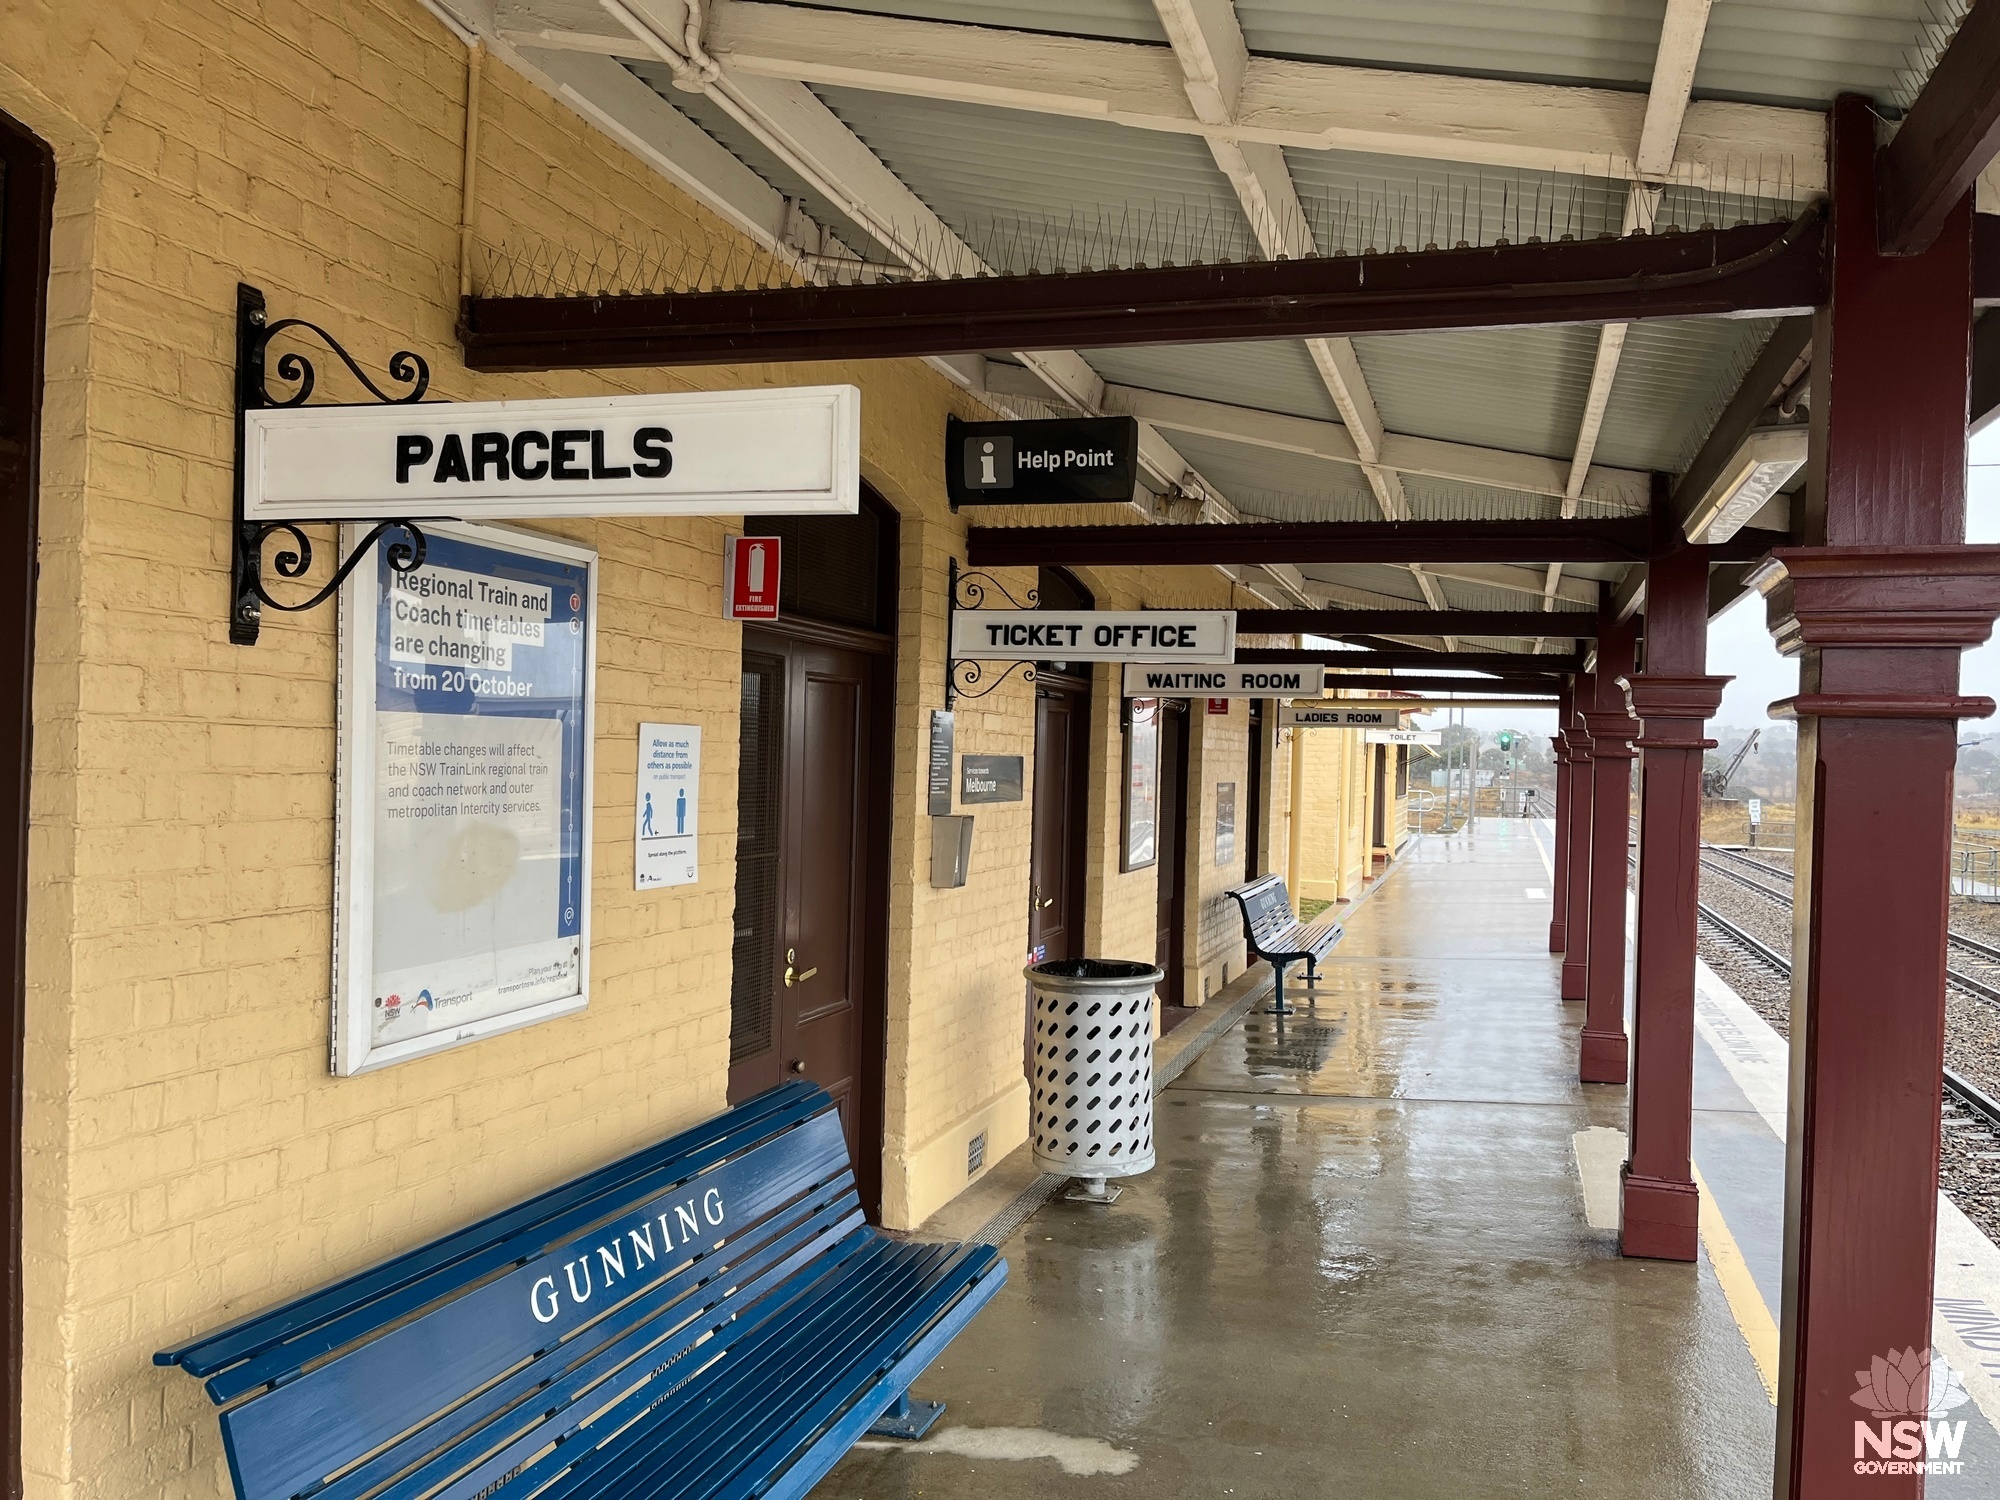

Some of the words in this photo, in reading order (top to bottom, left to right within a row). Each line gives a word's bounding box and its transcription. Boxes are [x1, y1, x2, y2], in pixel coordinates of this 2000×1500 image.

[395, 427, 673, 484] PARCELS
[1018, 450, 1061, 473] Help
[1064, 448, 1114, 468] Point
[396, 570, 474, 601] Regional
[478, 581, 517, 607] Train
[521, 593, 548, 612] and
[749, 595, 762, 603] FIRE
[395, 599, 451, 627] Coach
[456, 609, 541, 639] timetables
[985, 624, 1083, 647] TICKET
[1094, 624, 1197, 648] OFFICE
[394, 635, 424, 654] are
[428, 635, 507, 666] changing
[393, 666, 437, 691] from
[441, 670, 465, 692] 20
[469, 672, 533, 697] October
[1241, 674, 1300, 689] ROOM
[1295, 713, 1339, 723] LADIES
[1346, 713, 1382, 723] ROOM
[386, 742, 441, 756] Timetable
[443, 742, 487, 759] changes
[488, 743, 505, 756] will
[507, 744, 535, 757] affect
[652, 739, 668, 748] Allow
[675, 740, 690, 748] much
[652, 750, 675, 759] distance
[675, 750, 688, 759] from
[388, 762, 406, 777] the
[409, 762, 437, 777] NSW
[439, 762, 486, 776] TrainLink
[488, 762, 526, 778] regional
[529, 763, 548, 776] train
[646, 761, 664, 770] others
[671, 761, 692, 771] possible
[388, 784, 409, 798] and
[411, 782, 443, 797] coach
[446, 781, 488, 796] network
[489, 781, 507, 795] and
[509, 782, 534, 795] outer
[965, 777, 997, 793] Melbourne
[387, 803, 458, 820] metropolitan
[460, 801, 500, 816] Intercity
[502, 800, 541, 814] services.
[434, 991, 473, 1009] Transport
[385, 1007, 401, 1018] NSW
[530, 1187, 725, 1323] GUNNING
